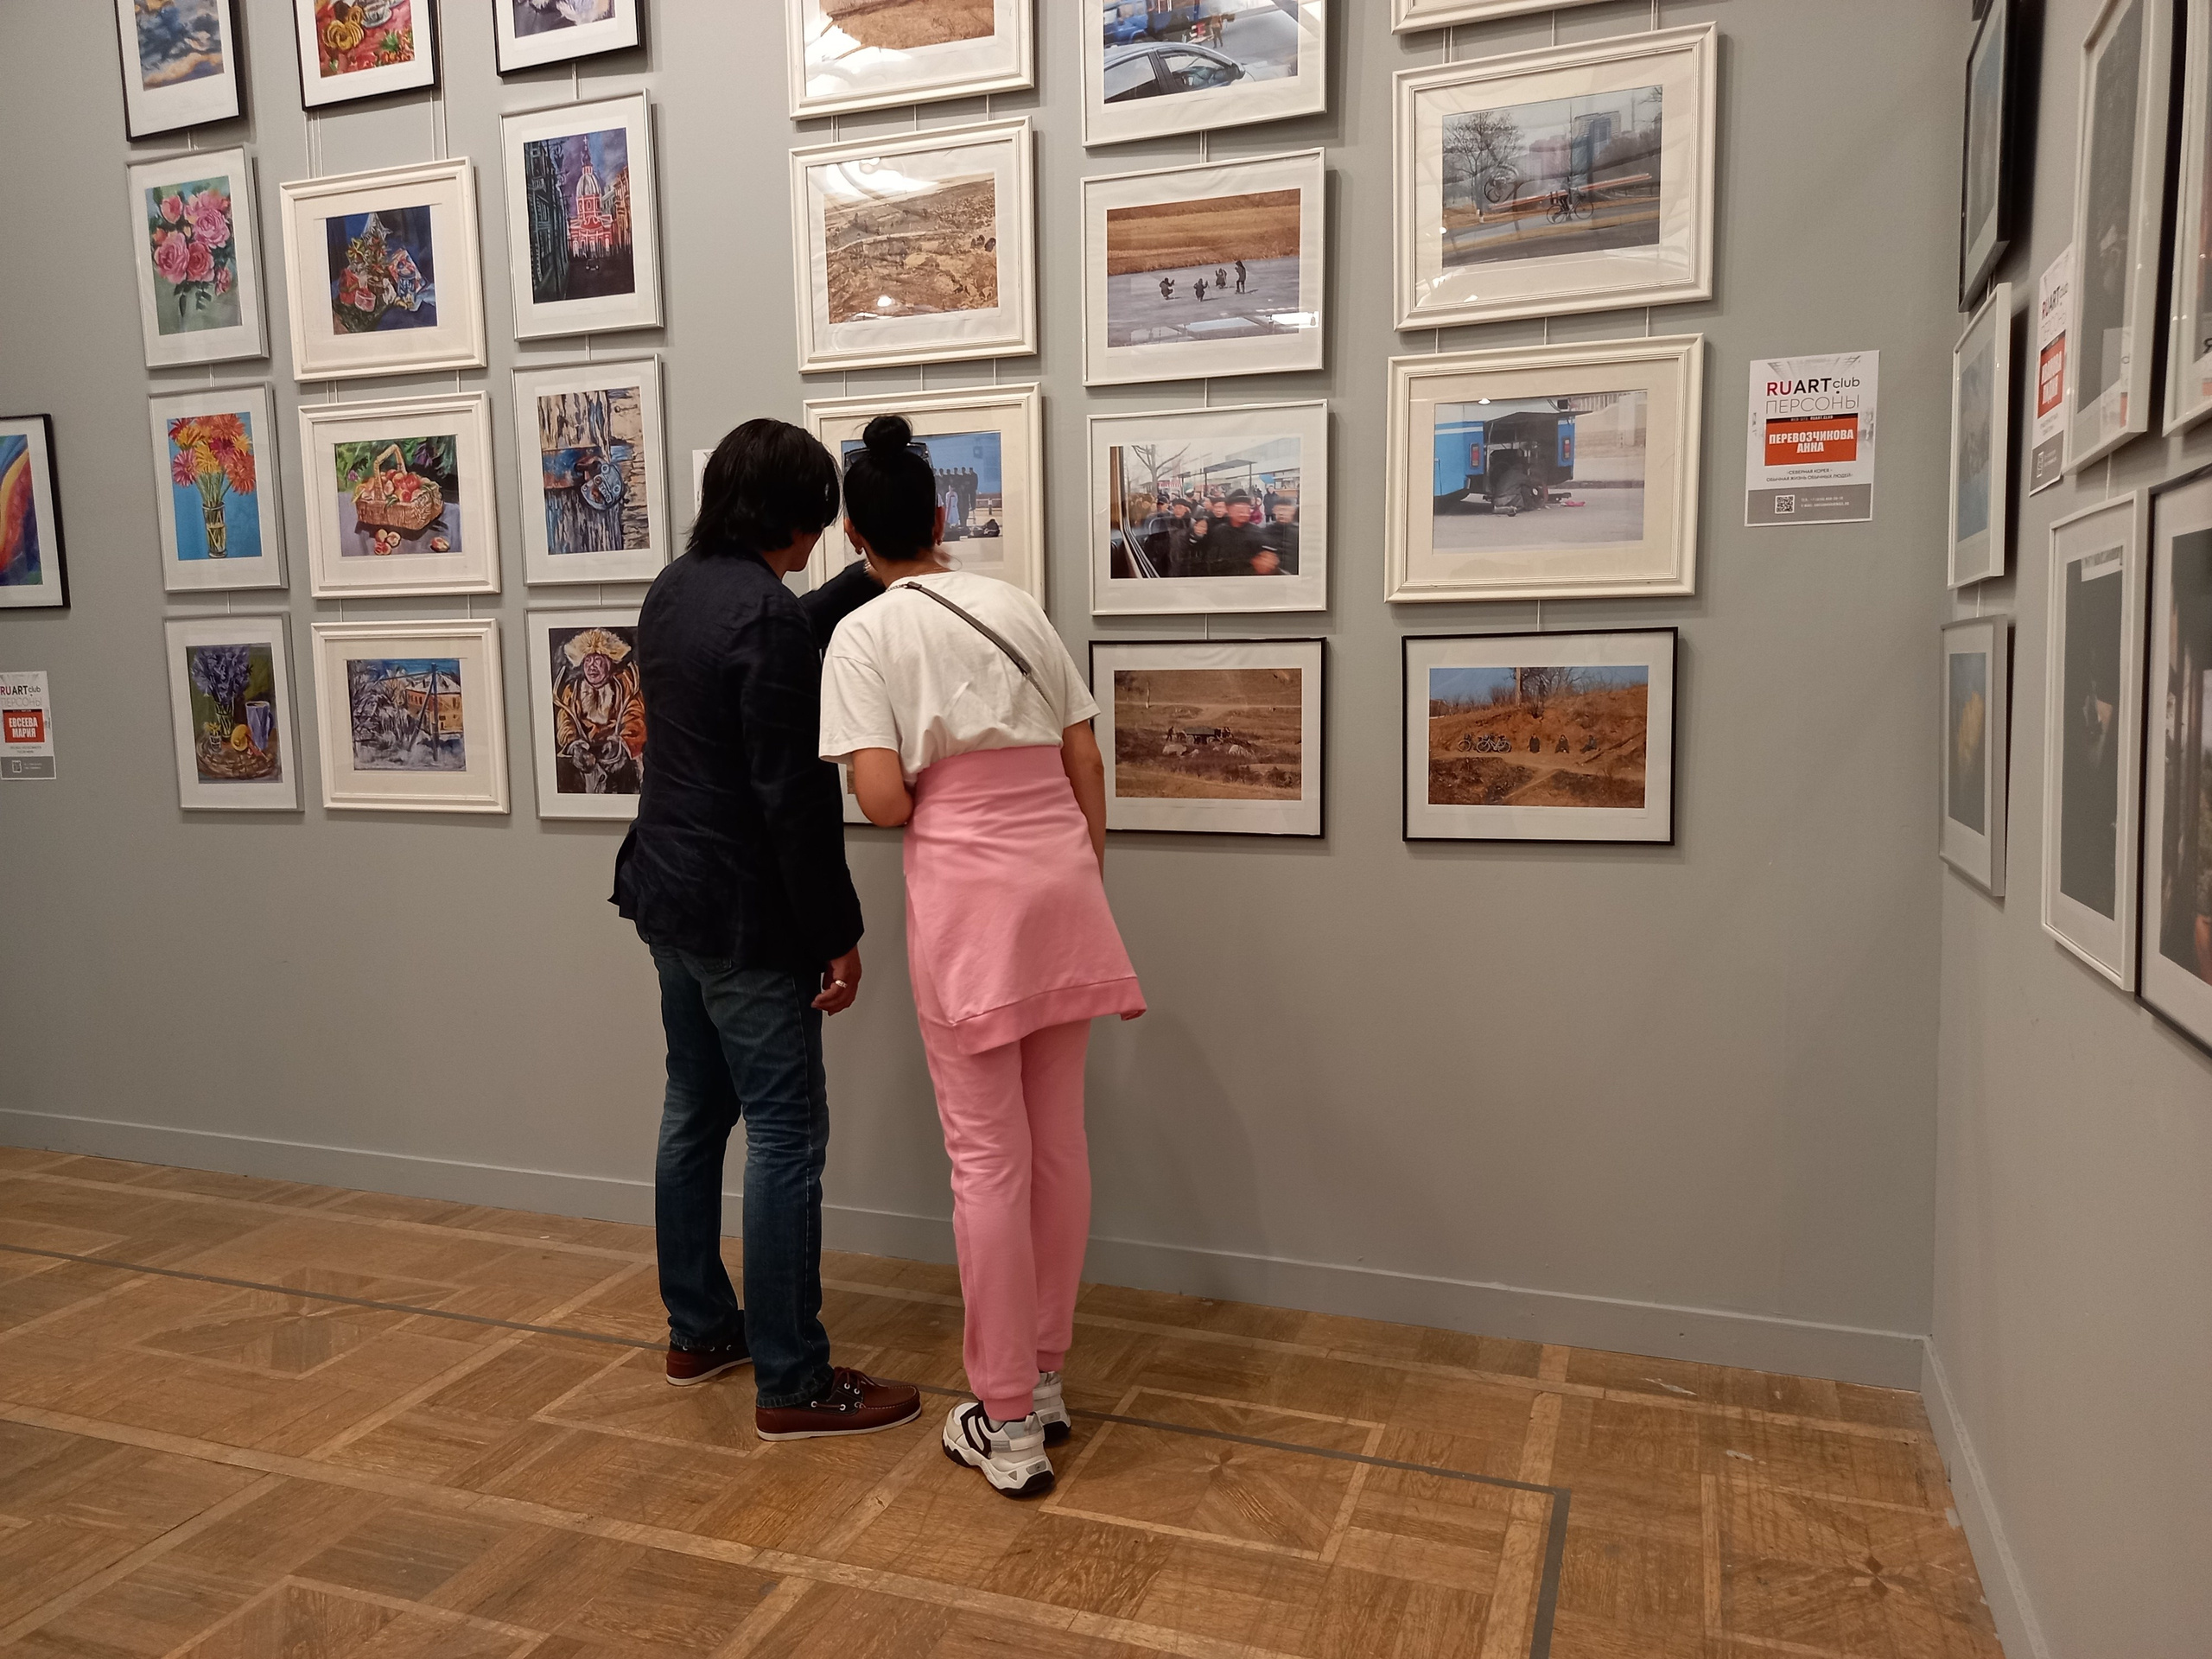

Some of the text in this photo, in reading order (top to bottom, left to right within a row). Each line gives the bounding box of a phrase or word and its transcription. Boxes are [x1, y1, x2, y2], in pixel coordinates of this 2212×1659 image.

[1765, 394, 1859, 415] ПЕРСОНЫ
[1769, 429, 1854, 445] ПЕРЕВОЗЧИКОВА
[1796, 442, 1824, 453] АННА
[9, 717, 39, 728] ЕВСЕЕВА
[12, 728, 36, 738] МАРИЯ
